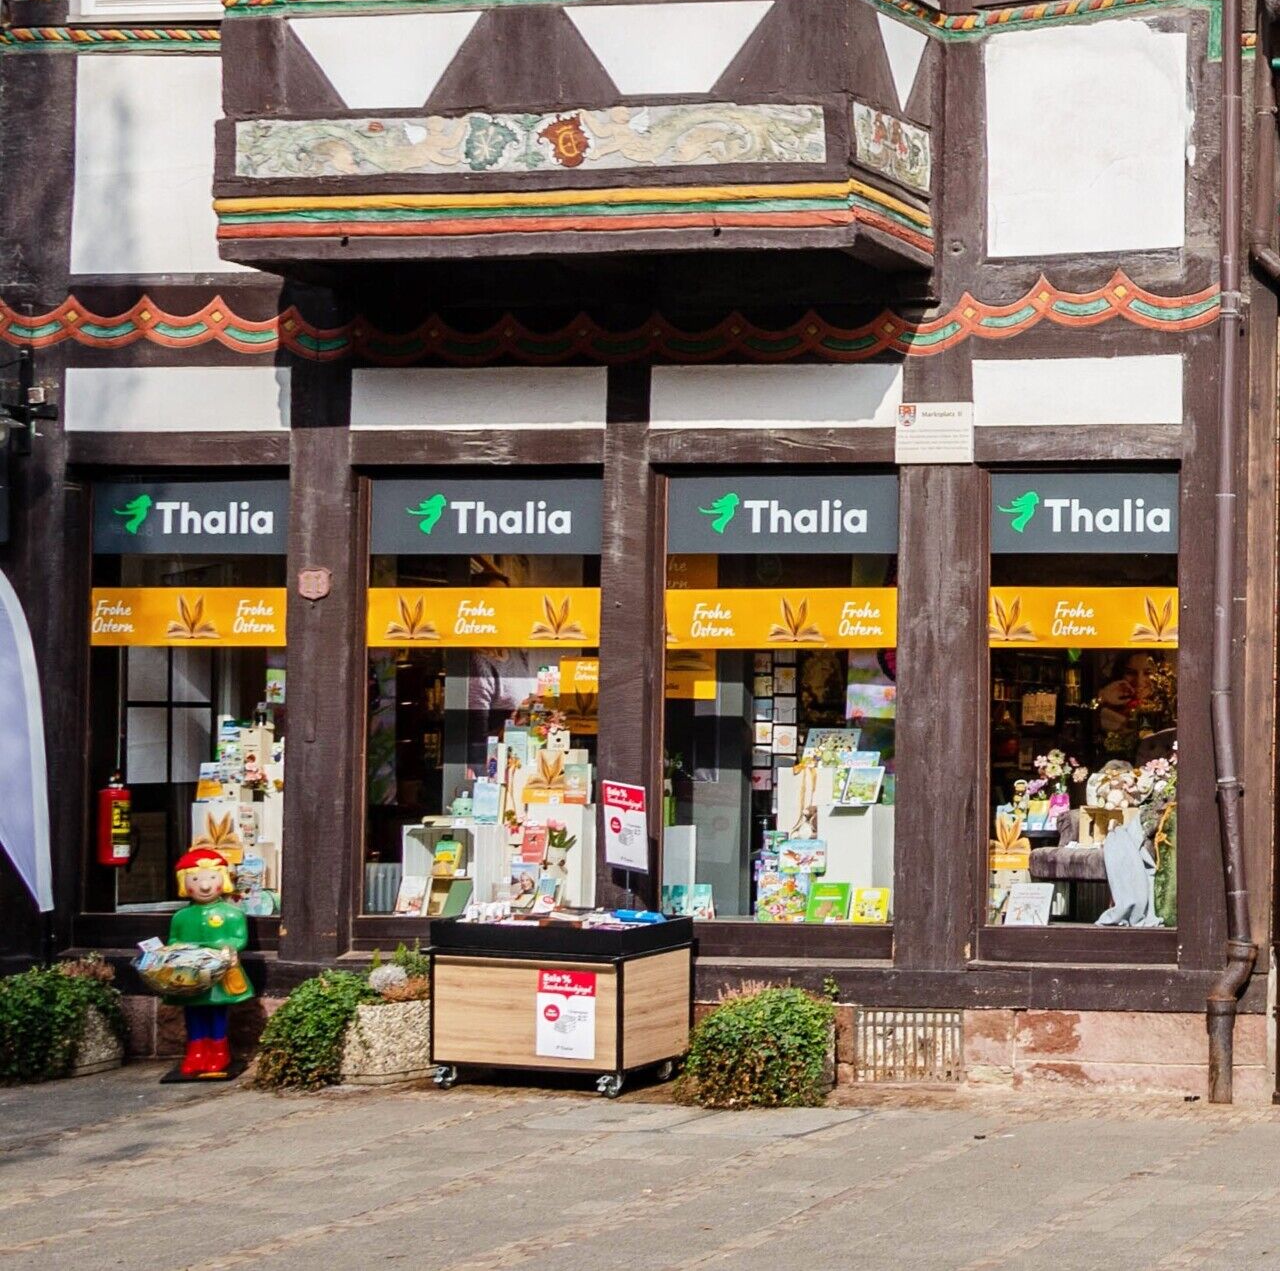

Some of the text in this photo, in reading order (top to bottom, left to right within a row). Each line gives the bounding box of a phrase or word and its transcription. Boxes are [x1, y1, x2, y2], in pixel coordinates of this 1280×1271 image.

[156, 501, 274, 534] Thalia
[451, 500, 572, 534] Thalia
[744, 499, 867, 533] Thalia
[1044, 498, 1171, 533] Thalia
[95, 599, 132, 616] Frohe
[236, 599, 274, 616] Frohe
[457, 600, 495, 617] Frohe
[692, 603, 733, 621] Frohe
[842, 601, 881, 619] Frohe
[1054, 600, 1094, 619] Frohe
[92, 617, 135, 633] Ostern
[233, 617, 276, 633] Ostern
[454, 618, 498, 635] Ostern
[691, 620, 736, 638] Ostern
[838, 619, 883, 637] Ostern
[1052, 619, 1098, 637] Ostern
